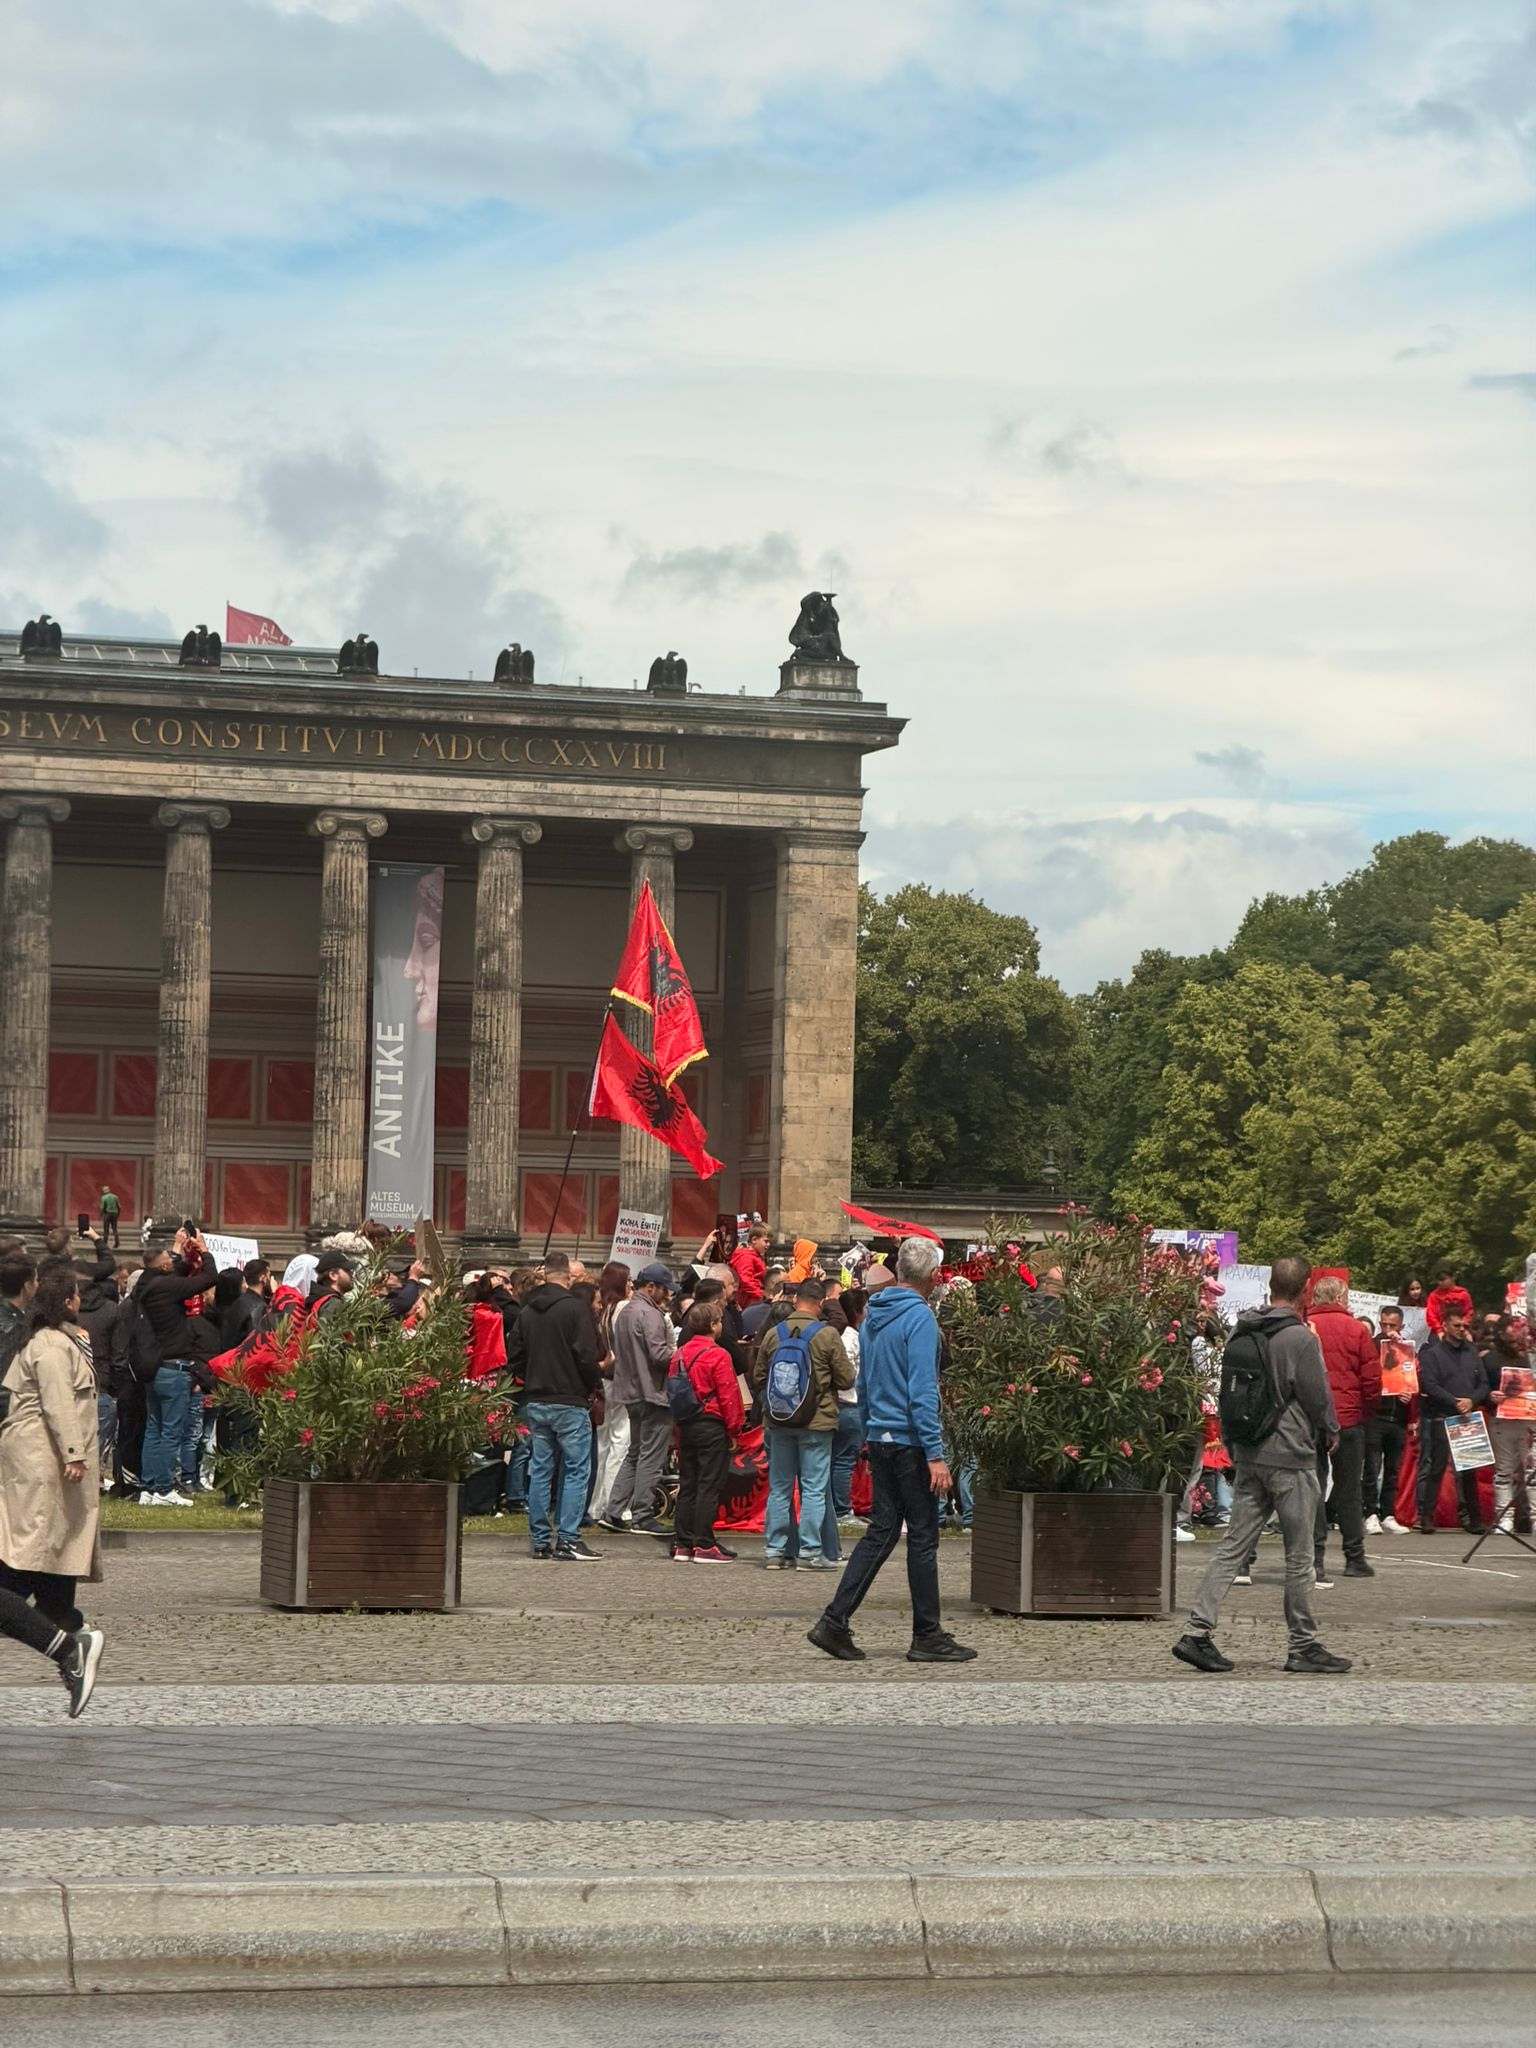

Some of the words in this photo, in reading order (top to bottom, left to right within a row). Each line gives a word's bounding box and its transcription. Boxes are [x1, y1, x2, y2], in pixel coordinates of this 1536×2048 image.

[131, 717, 392, 757] CONSTITVIT
[412, 732, 667, 770] MDCCCXXVIII
[373, 1022, 404, 1159] ANTIKE
[370, 1191, 401, 1202] ALTES
[370, 1202, 415, 1213] MUSEUM
[1225, 1264, 1261, 1281] RAMA
